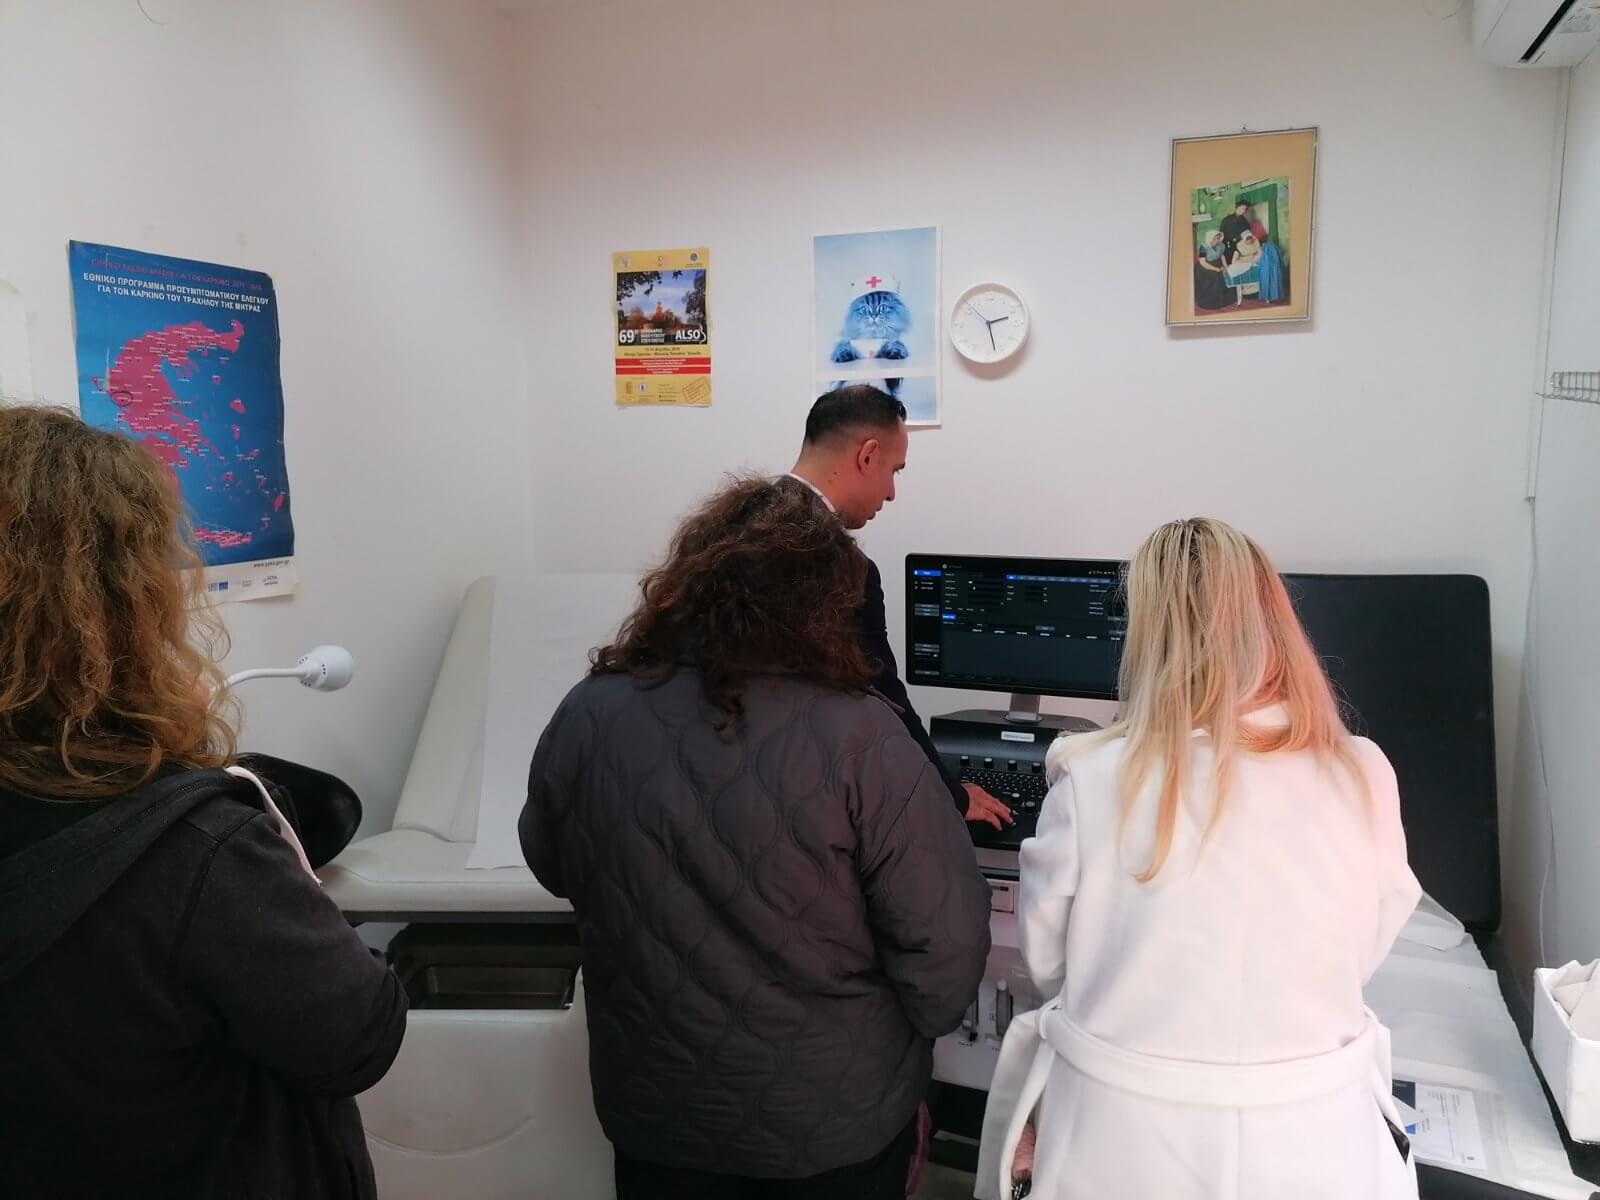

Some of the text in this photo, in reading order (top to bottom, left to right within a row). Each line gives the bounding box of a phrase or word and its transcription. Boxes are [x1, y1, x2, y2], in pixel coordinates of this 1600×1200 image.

[83, 272, 116, 284] ΕΘΝΙΚΟ
[118, 277, 165, 291] ΠΡΟΓΡΑΜΜΑ
[241, 294, 269, 305] ΕΛΕΓΧΟΥ
[97, 284, 261, 313] ΓΙΑ ΤΟΝ ΚΑΡΚΙΝΟ ΤΟΥ ΤΡΑΧΗΛΟΥ ΤΗΣ ΜΗΤΡΑΣ
[675, 329, 701, 340] ALSO
